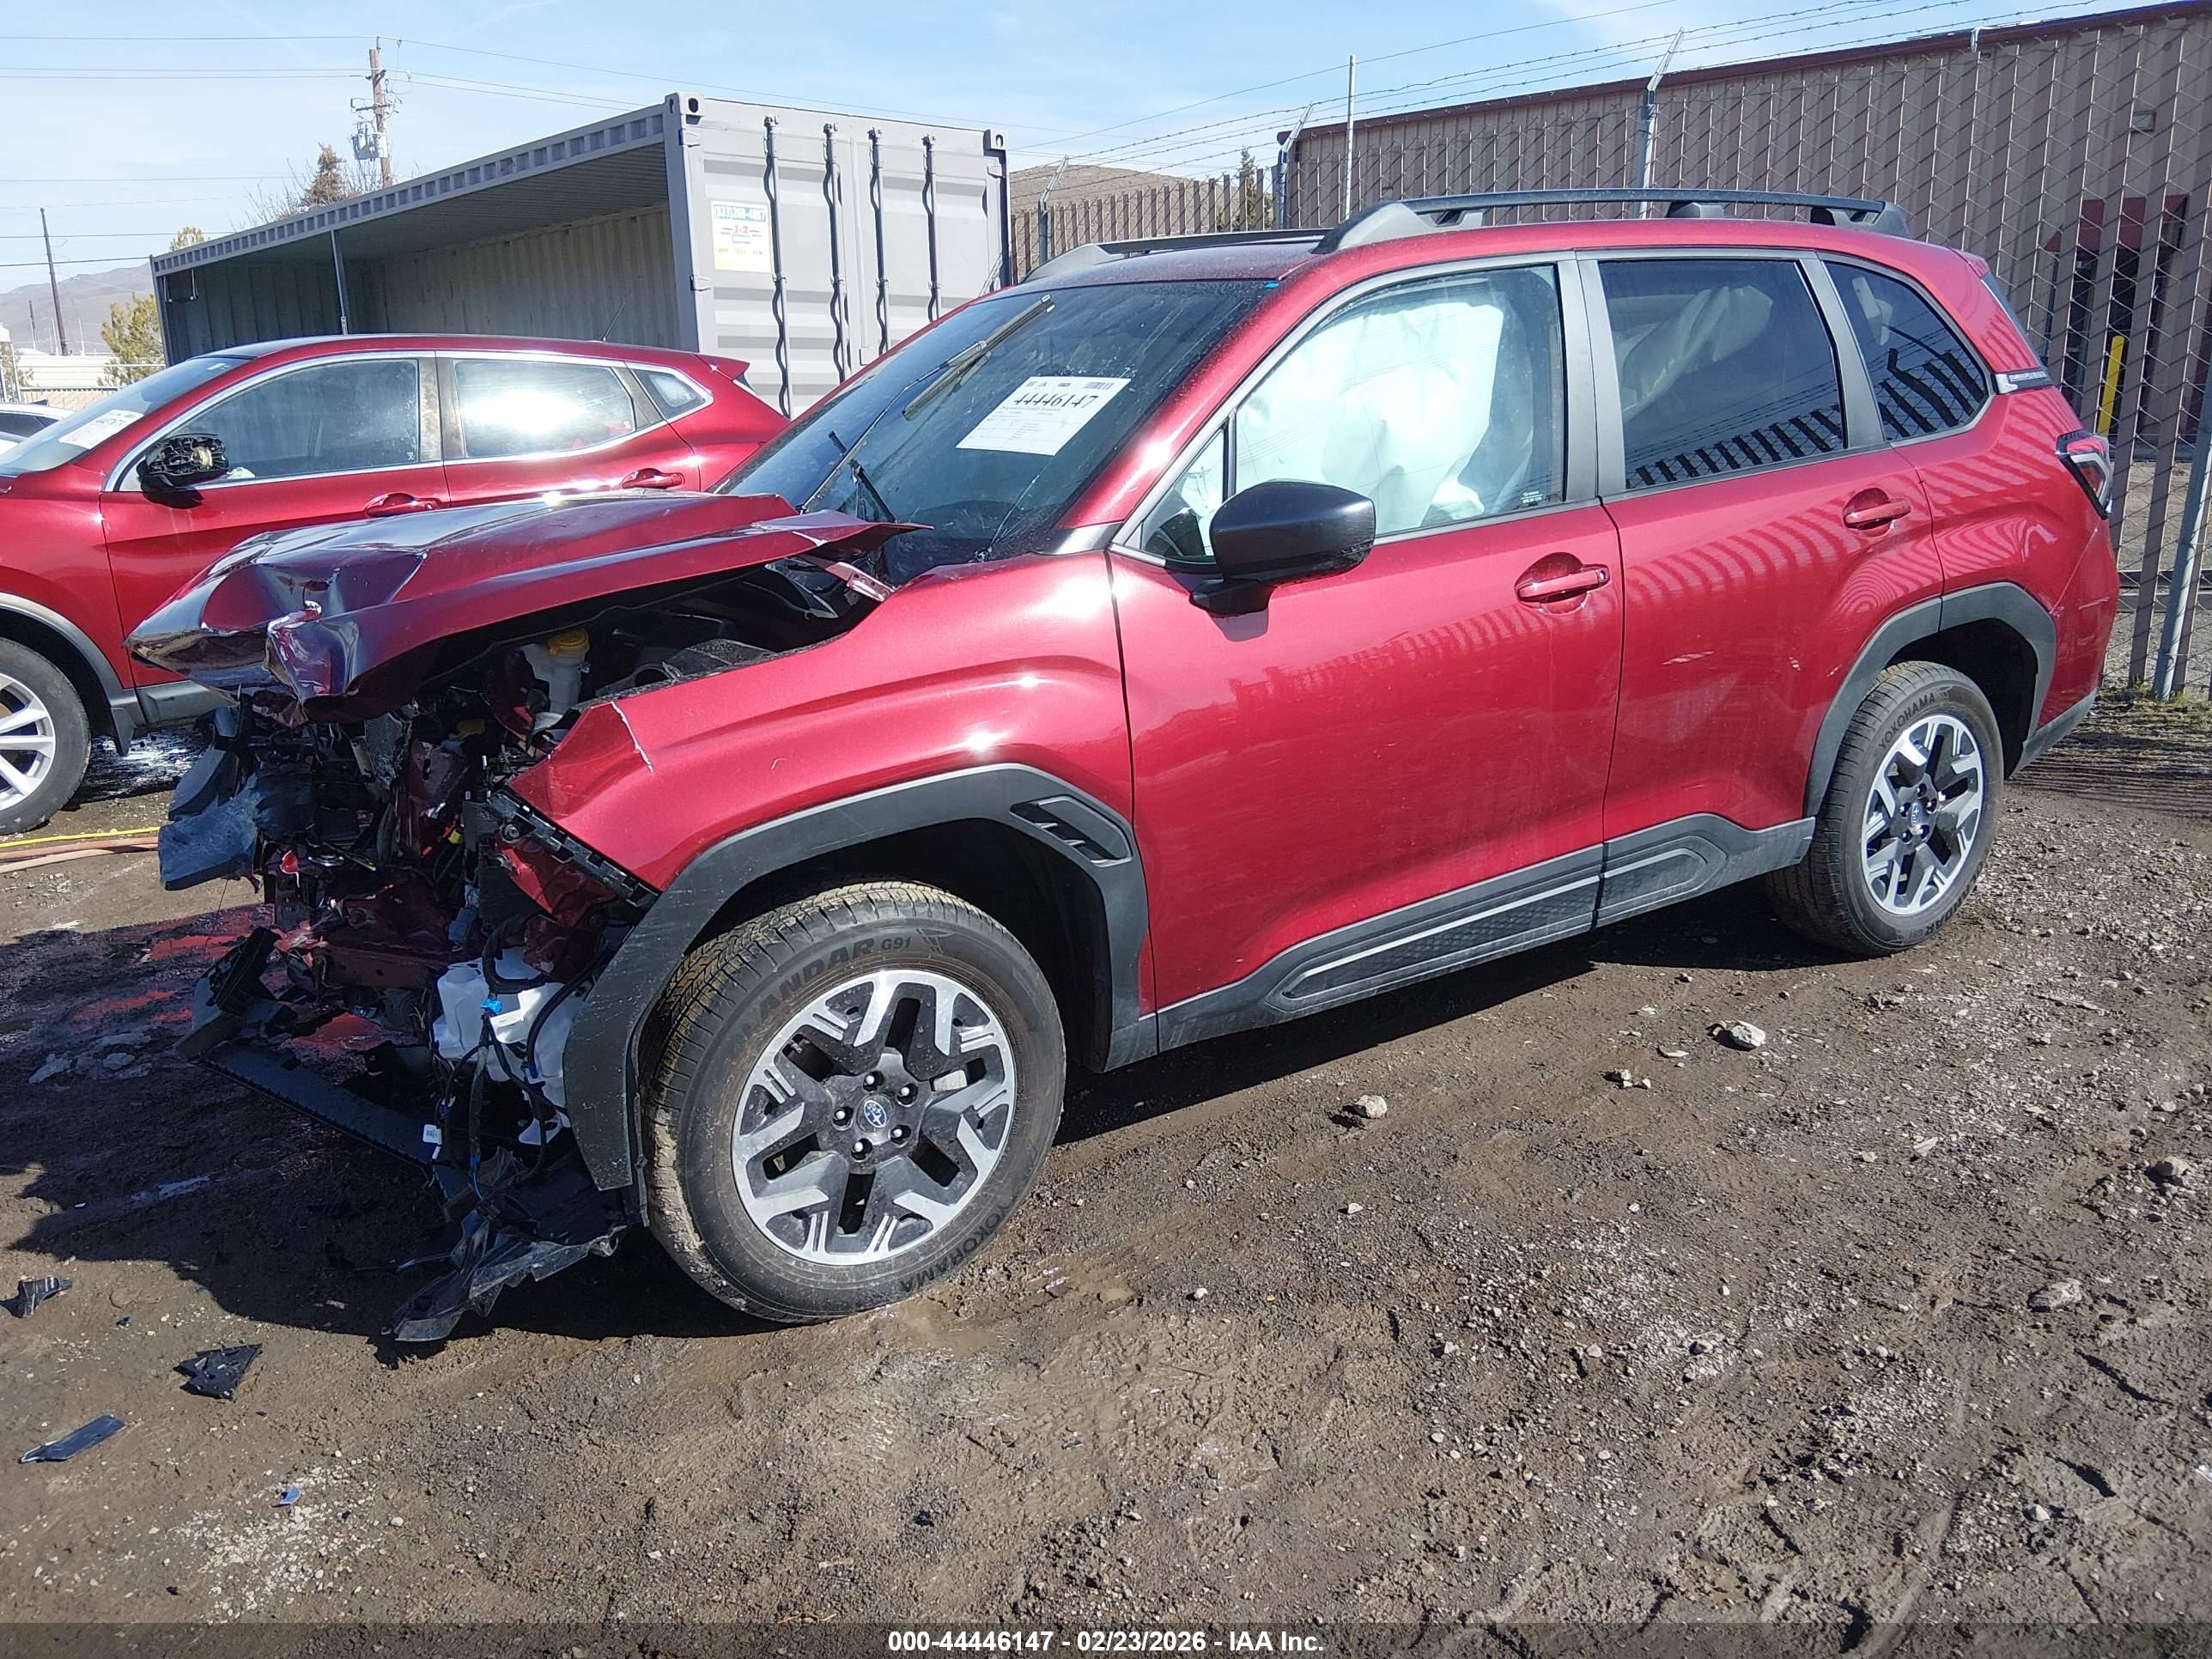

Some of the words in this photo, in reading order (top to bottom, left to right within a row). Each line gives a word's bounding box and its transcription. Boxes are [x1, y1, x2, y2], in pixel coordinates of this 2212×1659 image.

[1013, 392, 1100, 409] 44446147
[1878, 692, 1936, 750] YOKOHAMA
[880, 936, 912, 950] G91
[900, 1203, 1011, 1293] YOKOHAMA
